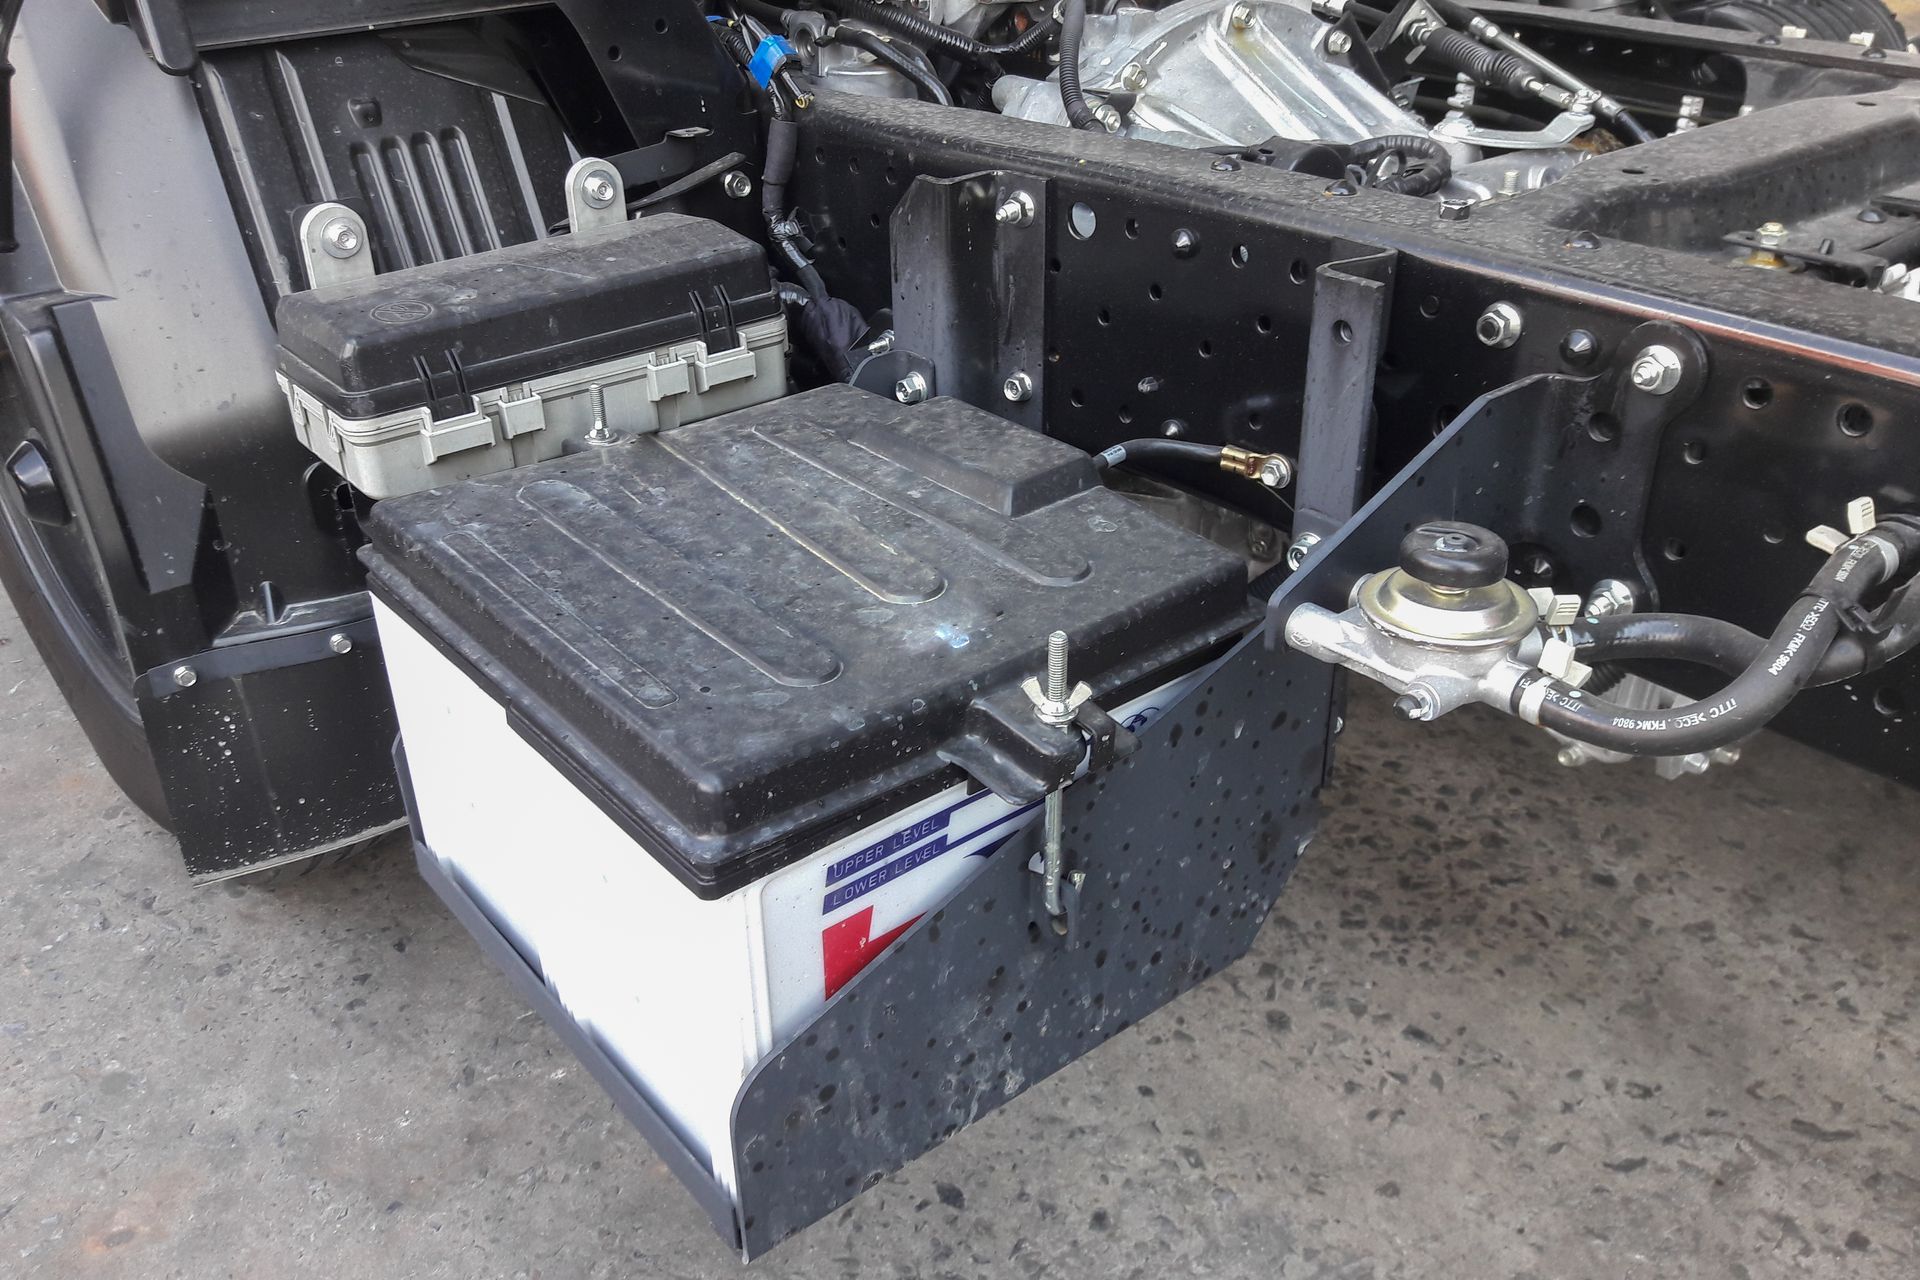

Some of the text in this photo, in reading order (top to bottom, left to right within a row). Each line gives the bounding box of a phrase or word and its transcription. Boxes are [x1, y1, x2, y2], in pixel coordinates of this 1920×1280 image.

[1767, 654, 1791, 676] 9804
[1612, 716, 1635, 729] 9804
[833, 819, 940, 878] UPPER LEVEL
[833, 844, 940, 906] LOWER LEVEL
